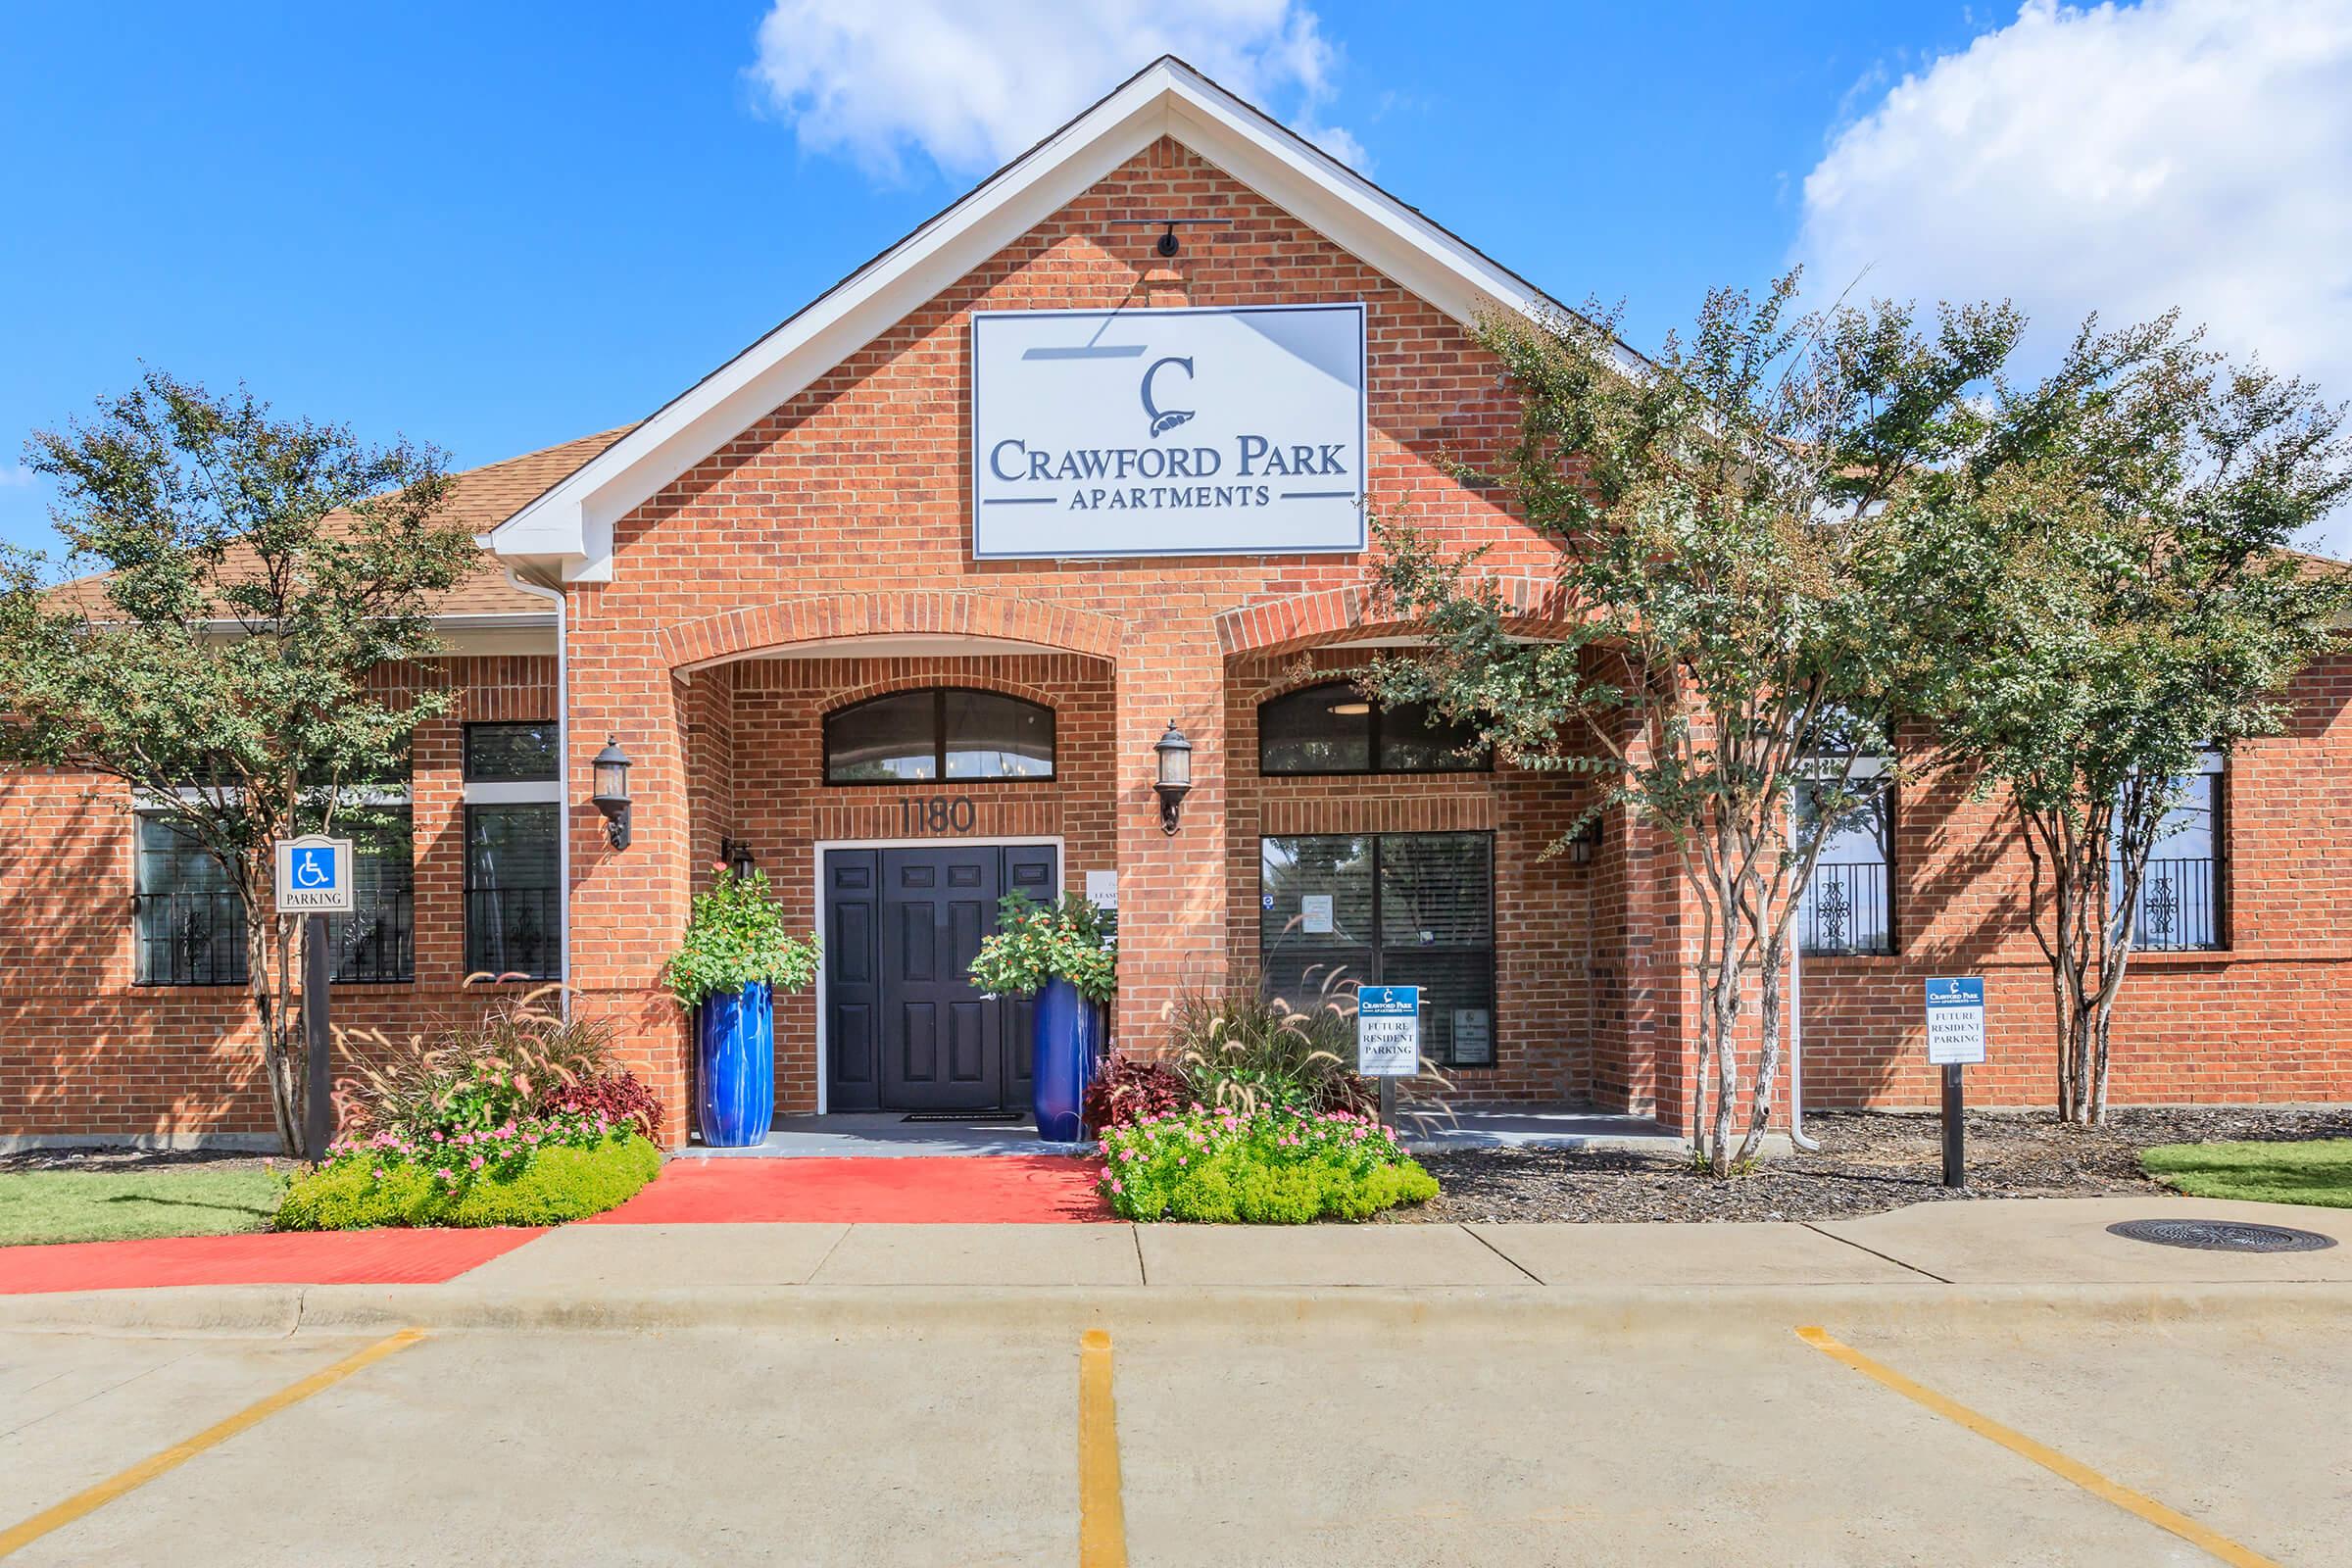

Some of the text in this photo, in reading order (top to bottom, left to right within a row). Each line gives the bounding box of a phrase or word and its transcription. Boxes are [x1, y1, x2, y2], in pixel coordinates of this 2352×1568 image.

[1141, 355, 1195, 437] C
[990, 434, 1348, 481] CRAWFORD PARK
[1069, 485, 1270, 511] APARTMENTS
[900, 795, 975, 832] 1180
[286, 893, 341, 905] PARKING
[1932, 1023, 1980, 1032] RESIDENT
